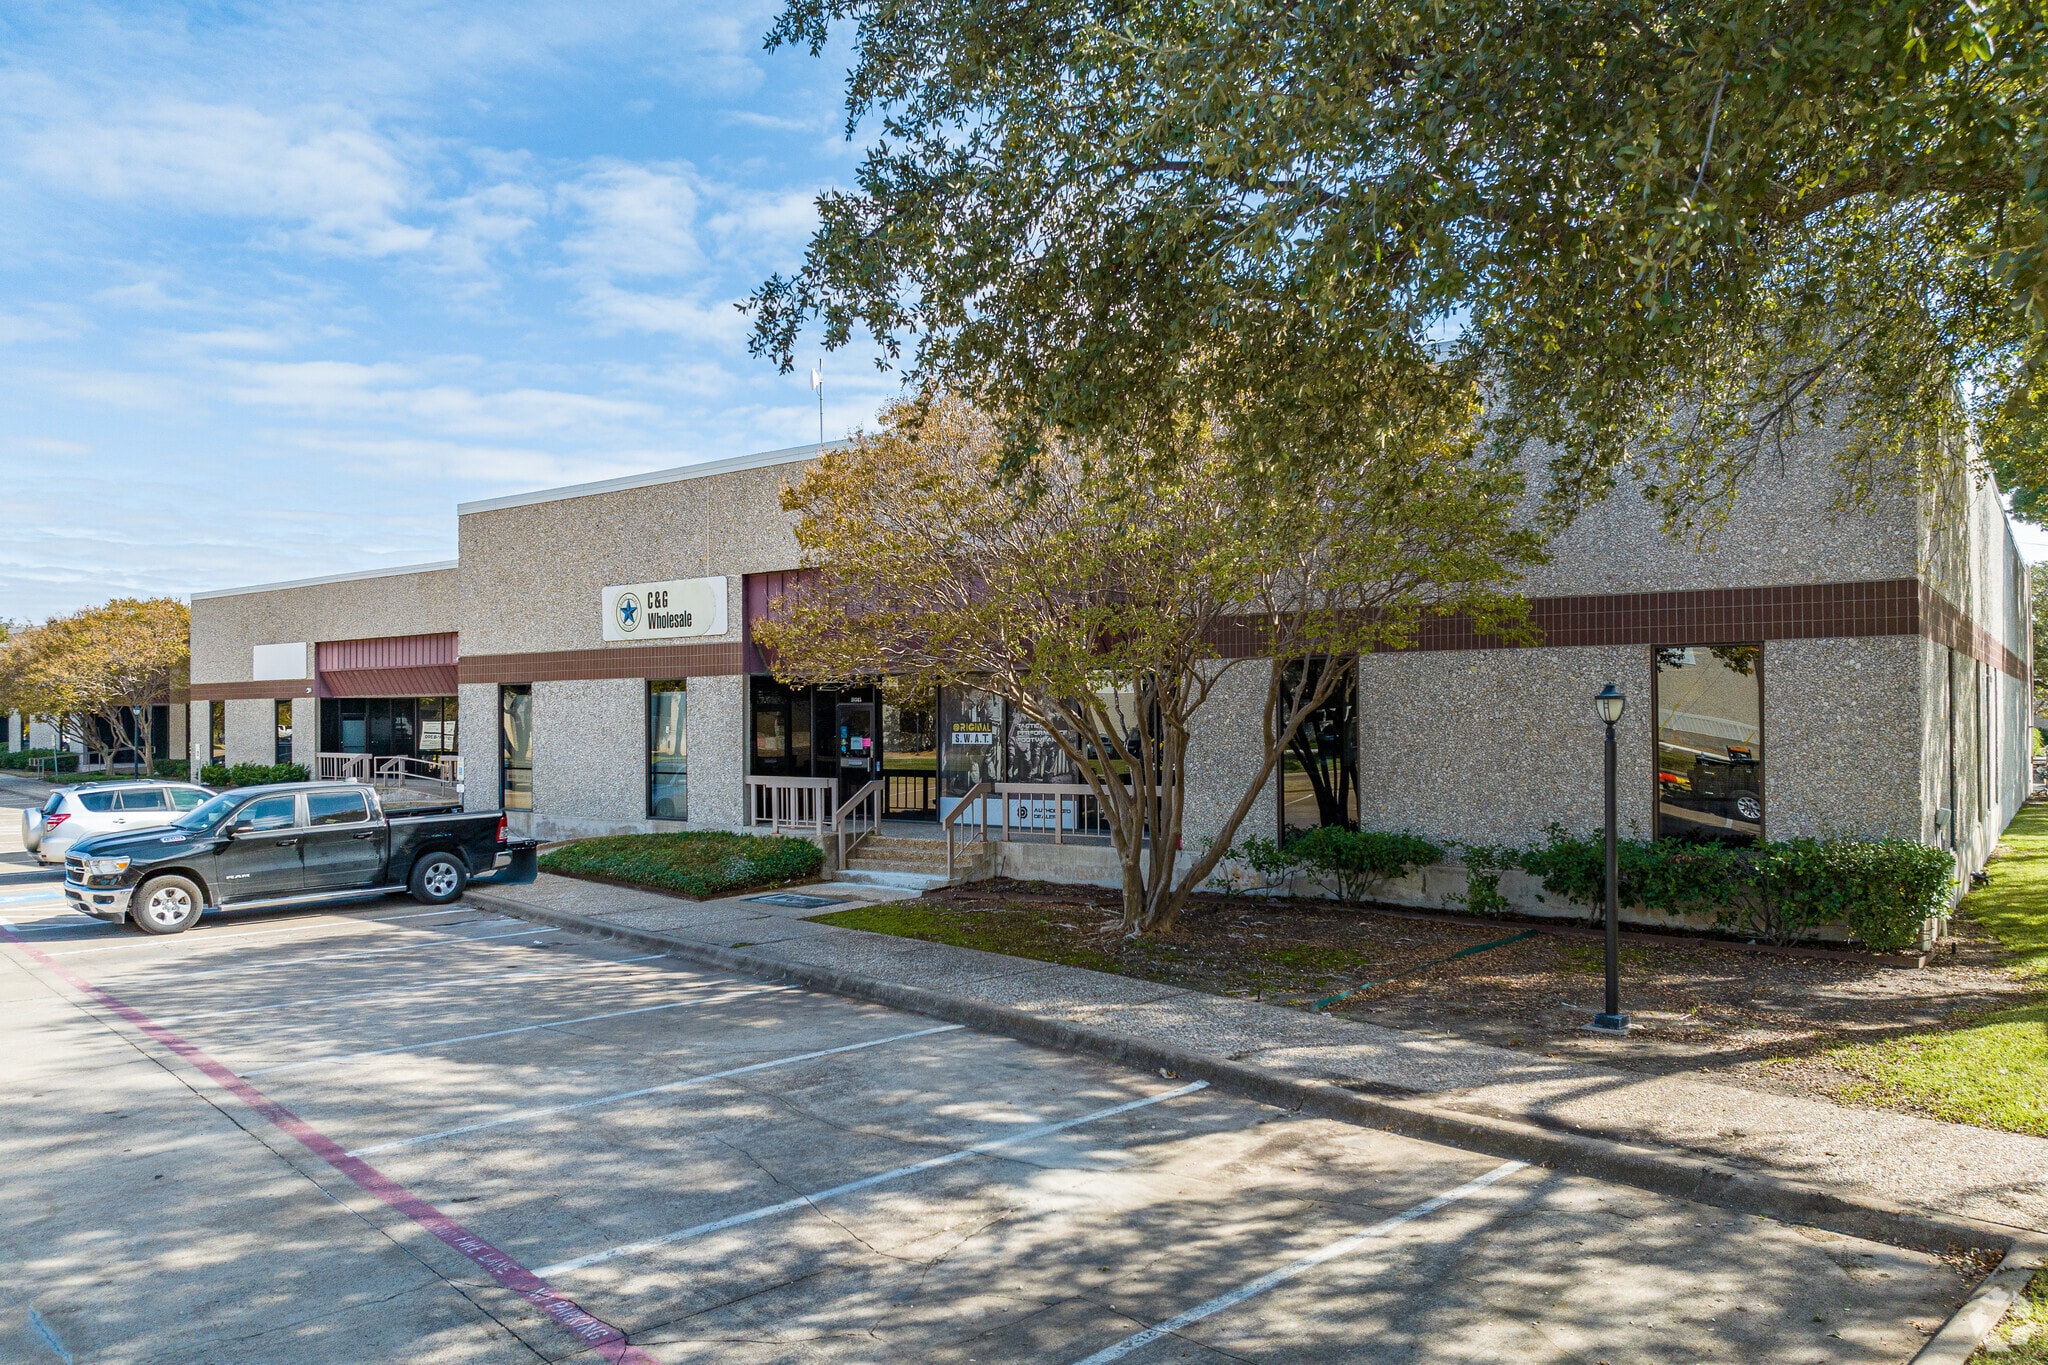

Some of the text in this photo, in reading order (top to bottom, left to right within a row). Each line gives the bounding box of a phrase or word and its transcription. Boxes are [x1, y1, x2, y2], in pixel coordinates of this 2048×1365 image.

[647, 610, 692, 629] Wholesale
[952, 722, 991, 732] ORIGINAL
[955, 733, 989, 743] S.W.A.T.
[453, 1235, 488, 1255] FIRE
[477, 1252, 519, 1275] LANE
[545, 1301, 609, 1340] PARKING
